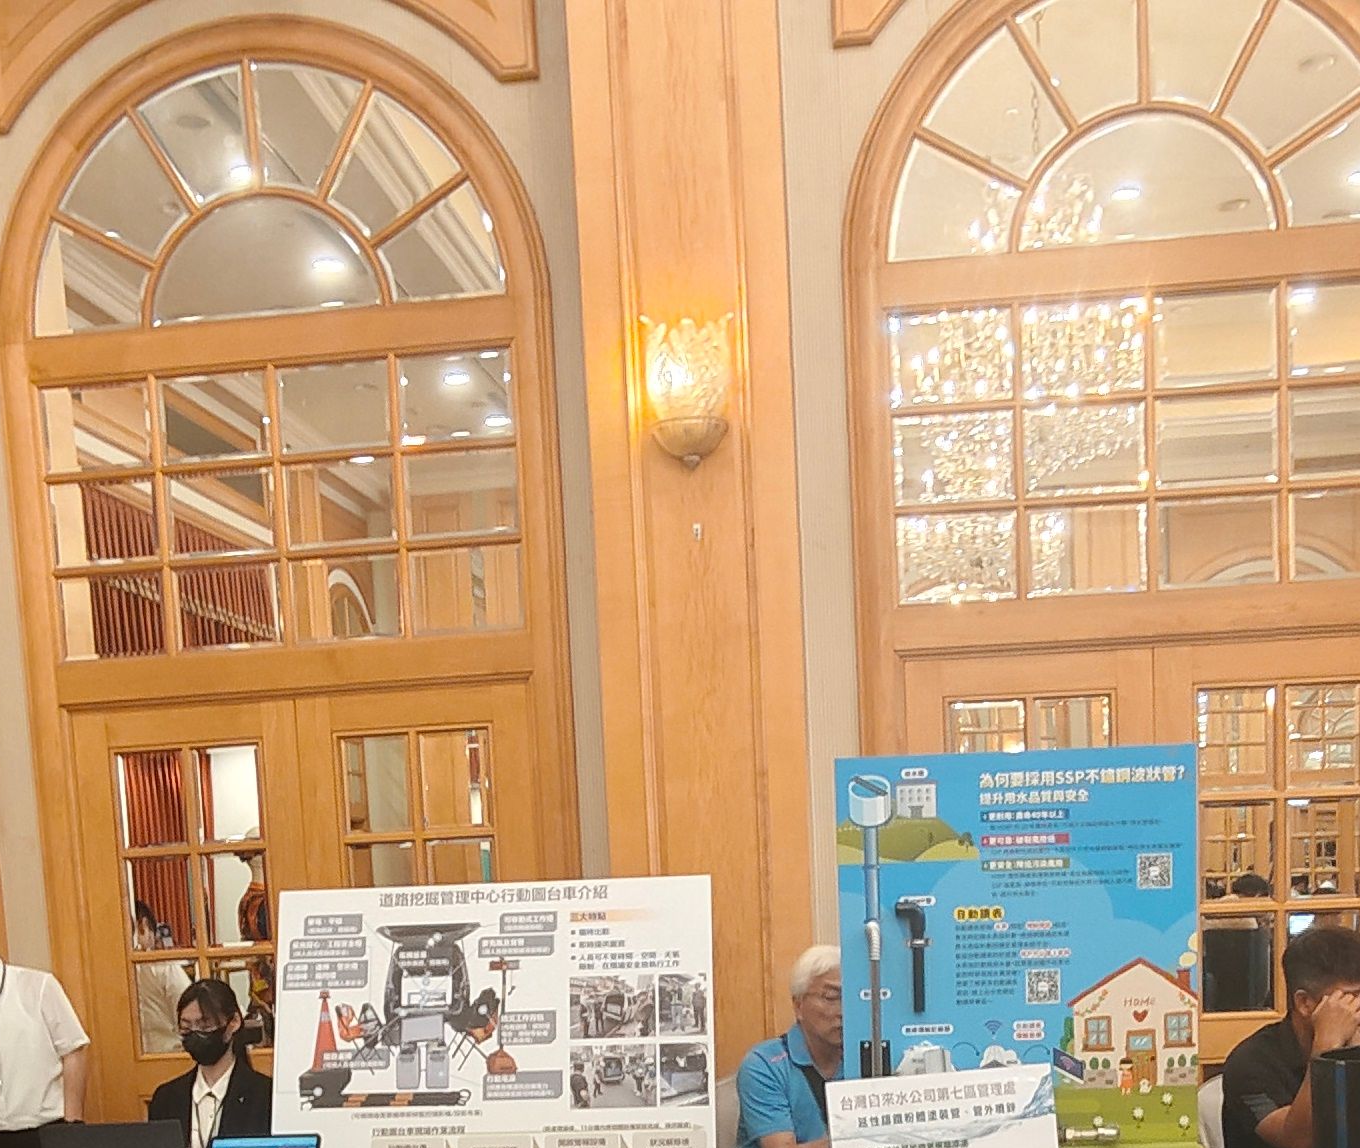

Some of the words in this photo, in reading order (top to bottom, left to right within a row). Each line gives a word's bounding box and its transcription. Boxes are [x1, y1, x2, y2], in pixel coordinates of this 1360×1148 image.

[379, 885, 608, 908] 道路挖掘管理中心行動圖台車介紹
[840, 1081, 1017, 1111] 台灣自來水公司第七區管理處
